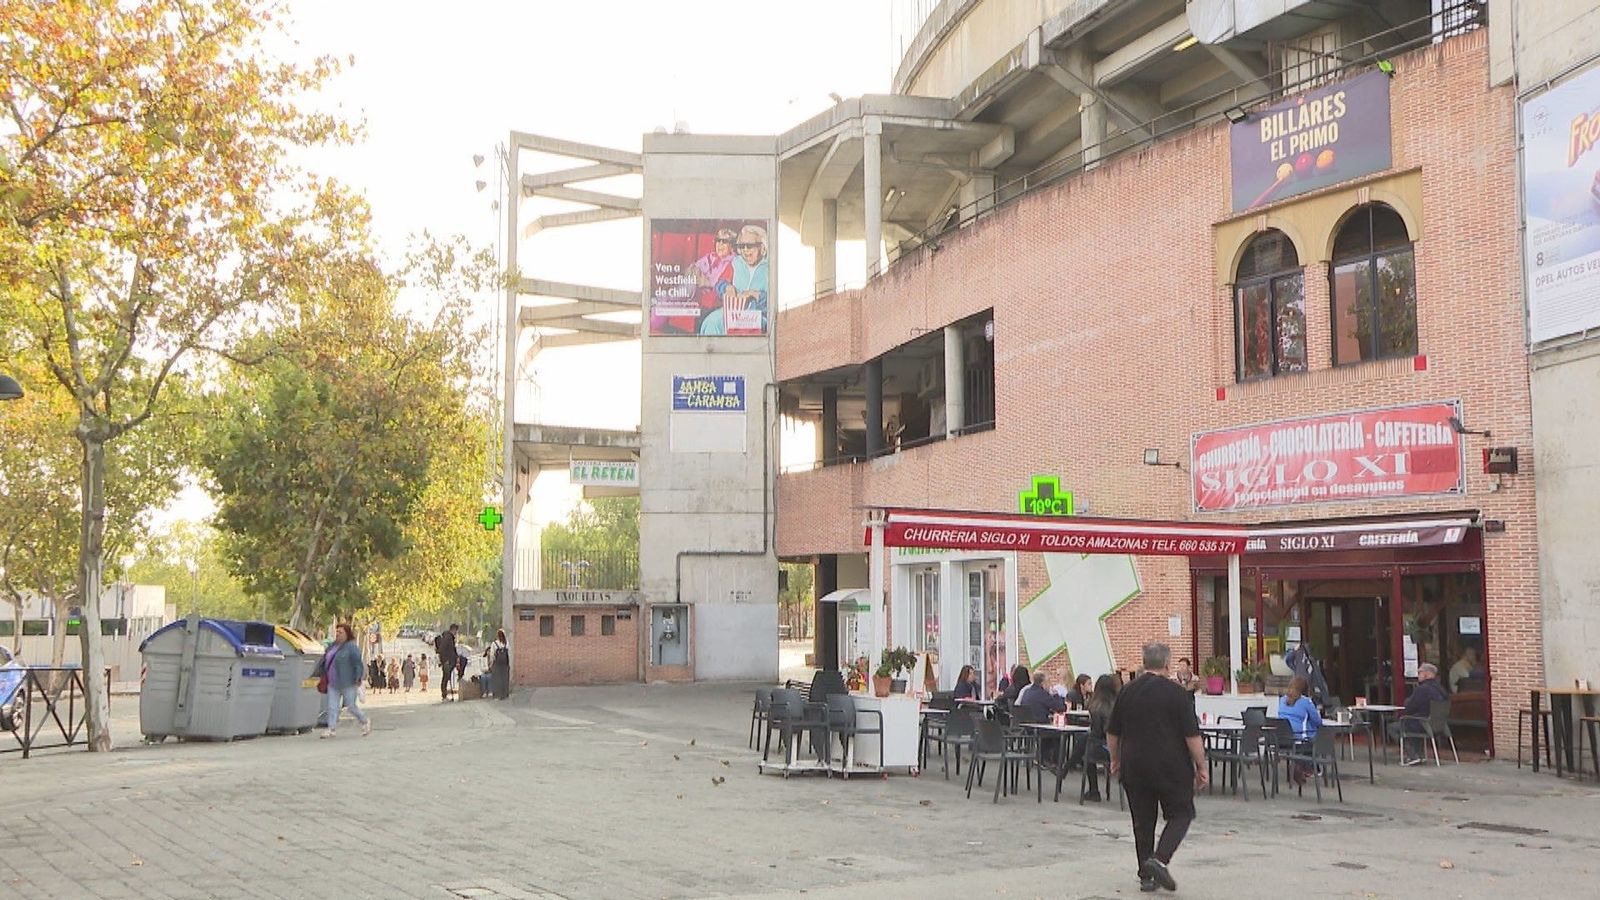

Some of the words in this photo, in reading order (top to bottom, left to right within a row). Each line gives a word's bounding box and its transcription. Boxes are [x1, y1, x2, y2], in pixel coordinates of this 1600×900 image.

[1260, 91, 1346, 143] BILLARES
[1270, 141, 1286, 162] EL
[1289, 122, 1339, 156] PRIMO
[655, 263, 673, 272] Ven
[1557, 263, 1585, 280] AUTOS
[655, 275, 697, 285] Westfield
[655, 288, 667, 297] de
[687, 395, 740, 408] CARAMBA
[1269, 416, 1364, 458] CHOCOLATERÍA
[1374, 420, 1453, 448] CAFETERÍA
[1201, 459, 1338, 493] SIGLO
[1352, 452, 1411, 478] XI
[1311, 486, 1328, 496] en
[1329, 480, 1405, 495] desayunos
[904, 528, 977, 543] CHURRERIA
[980, 531, 1016, 545] SIGLO
[1018, 534, 1031, 546] XI
[1040, 534, 1086, 547] TOLDOS
[1086, 536, 1148, 550] AMAZONAS
[1179, 541, 1196, 551] 660
[1218, 541, 1236, 552] 371
[1280, 535, 1318, 550] SIGLO
[1321, 534, 1335, 548] XI
[1359, 530, 1419, 547] CAFETERÍA
